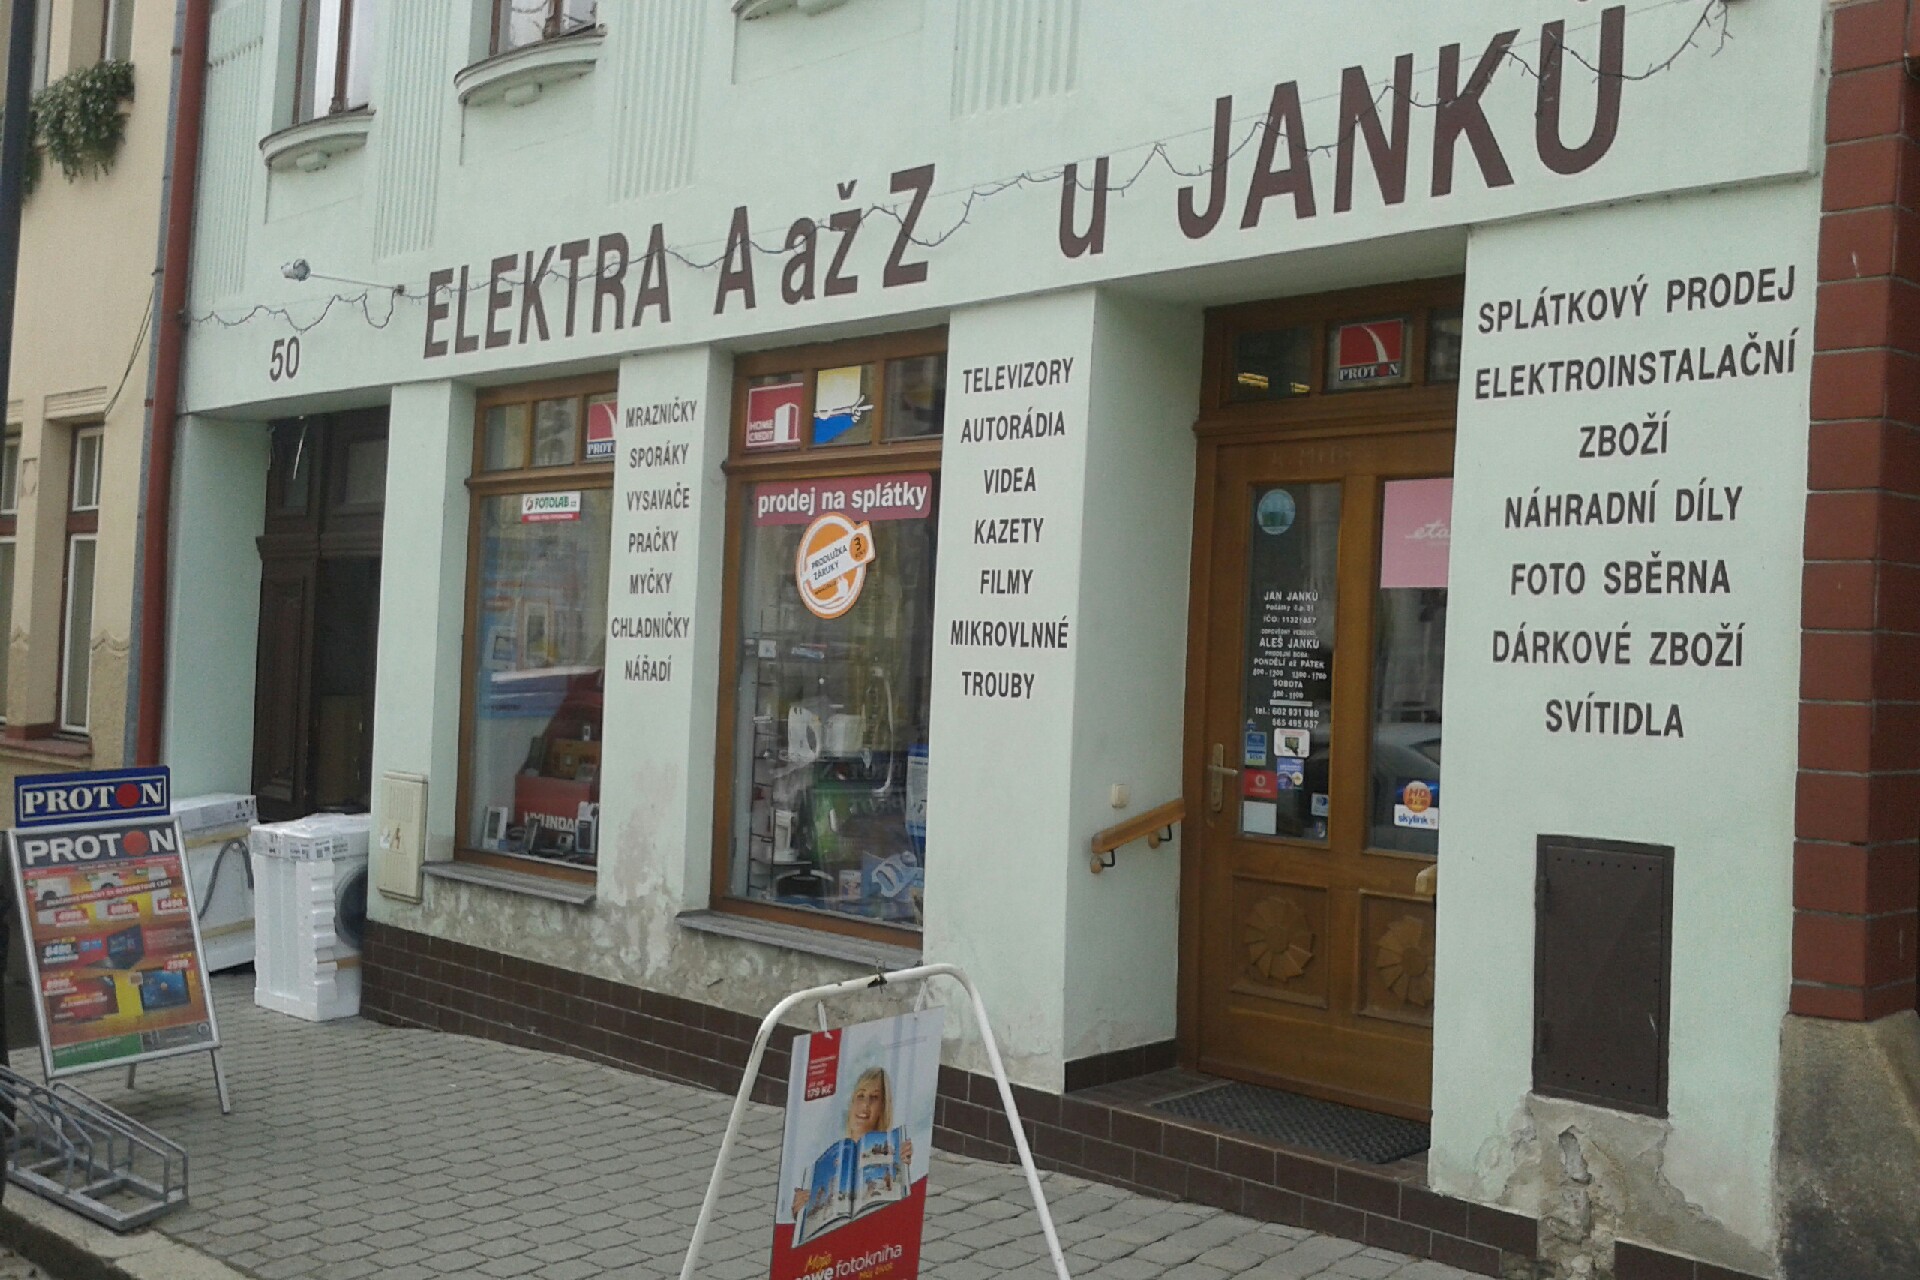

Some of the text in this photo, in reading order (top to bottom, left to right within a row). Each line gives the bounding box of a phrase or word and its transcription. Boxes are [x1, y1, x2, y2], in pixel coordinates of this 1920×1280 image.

[424, 222, 672, 359] ELEKTRA
[712, 203, 758, 318] A
[779, 178, 864, 308] až
[882, 163, 936, 288] Z
[1478, 264, 1796, 334] SPLÁTKOVÝ PRODEJ
[269, 335, 301, 381] 50
[962, 356, 1074, 394] TELEVIZORY
[1475, 326, 1800, 400] ELEKTROINSTALAČNÍ
[625, 396, 698, 429] MRAZNIČKY
[960, 406, 1066, 444] AUTORÁDIA
[1578, 409, 1671, 459] ZBOŽÍ
[629, 439, 690, 470] SPORÁKY
[626, 481, 690, 511] VYSAVAČE
[983, 466, 1037, 495] VIDEA
[758, 481, 927, 517] prodej na splátky
[1504, 476, 1743, 529] NÁHRADNÍ DÍLY
[628, 526, 679, 553] PRAČKY
[973, 517, 1044, 545] KAZETY
[629, 567, 673, 594] MYČKY
[979, 568, 1034, 595] FILMY
[1510, 550, 1731, 596] FOTO SBĚRNA
[1263, 591, 1282, 601] JAN
[611, 611, 690, 640] CHLADNIČKY
[950, 615, 1069, 649] MIKROVLNNÉ
[1492, 621, 1746, 667] DÁRKOVÉ ZBOŽÍ
[624, 654, 672, 682] NÁŘADÍ
[1273, 680, 1303, 688] SOBOTA
[961, 671, 1035, 700] TROUBY
[1545, 691, 1684, 739] SVÍTIDLA
[836, 1244, 903, 1278] fotokniha
